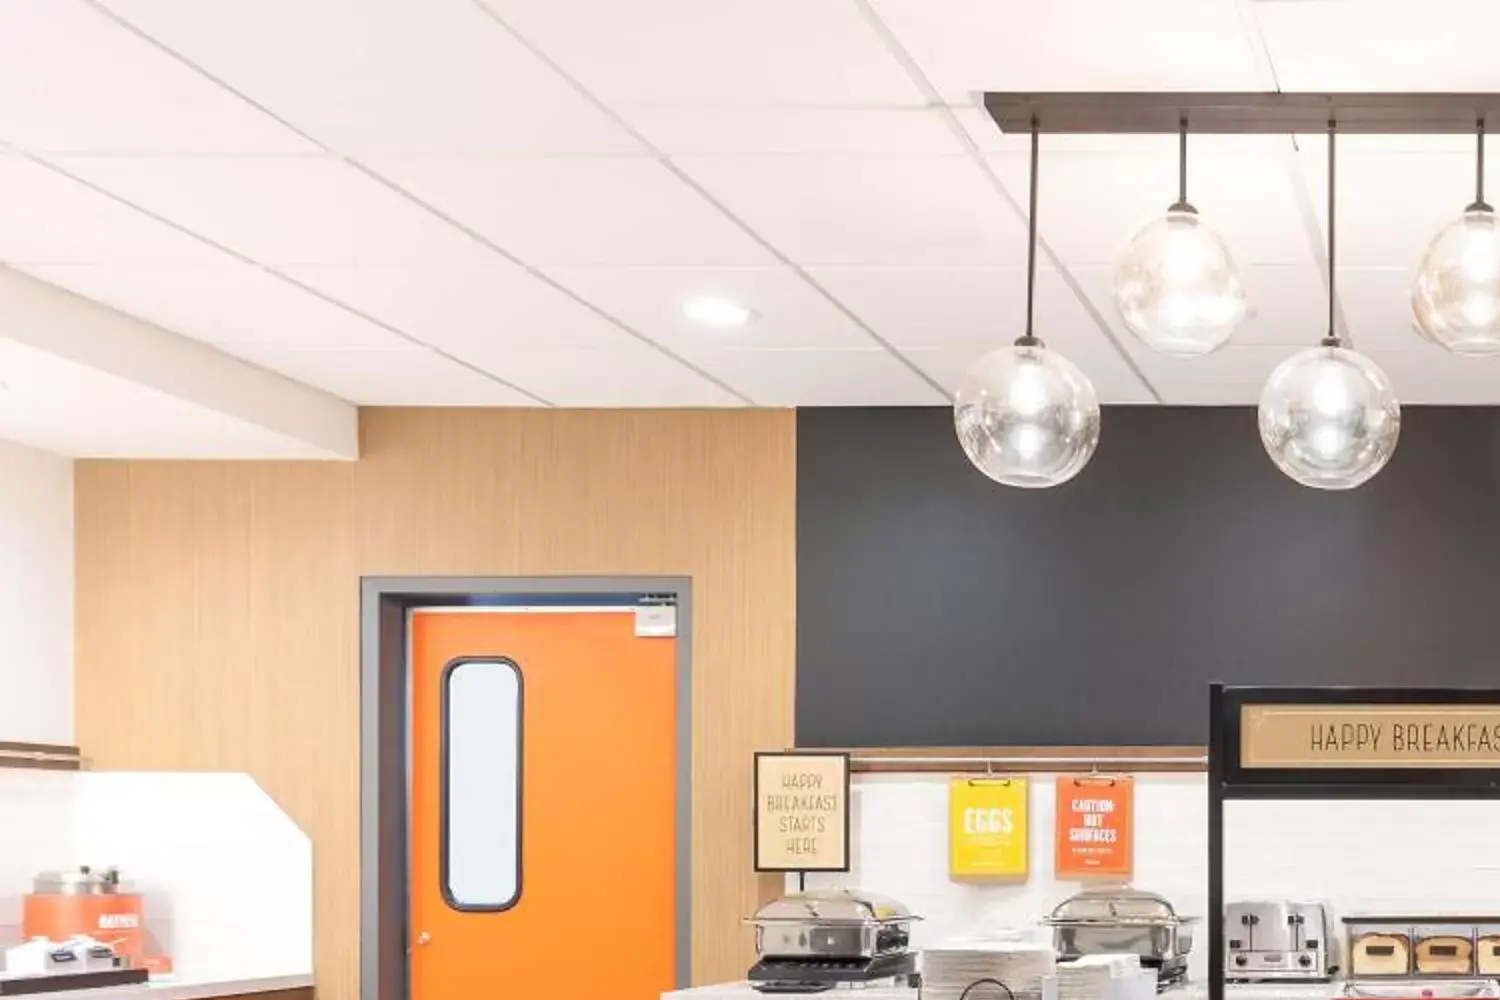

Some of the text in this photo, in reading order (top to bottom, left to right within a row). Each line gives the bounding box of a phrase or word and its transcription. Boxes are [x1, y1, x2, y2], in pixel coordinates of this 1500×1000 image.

[1310, 723, 1382, 752] HAPPY
[779, 815, 826, 833] STARTS
[963, 807, 1014, 835] EGGS
